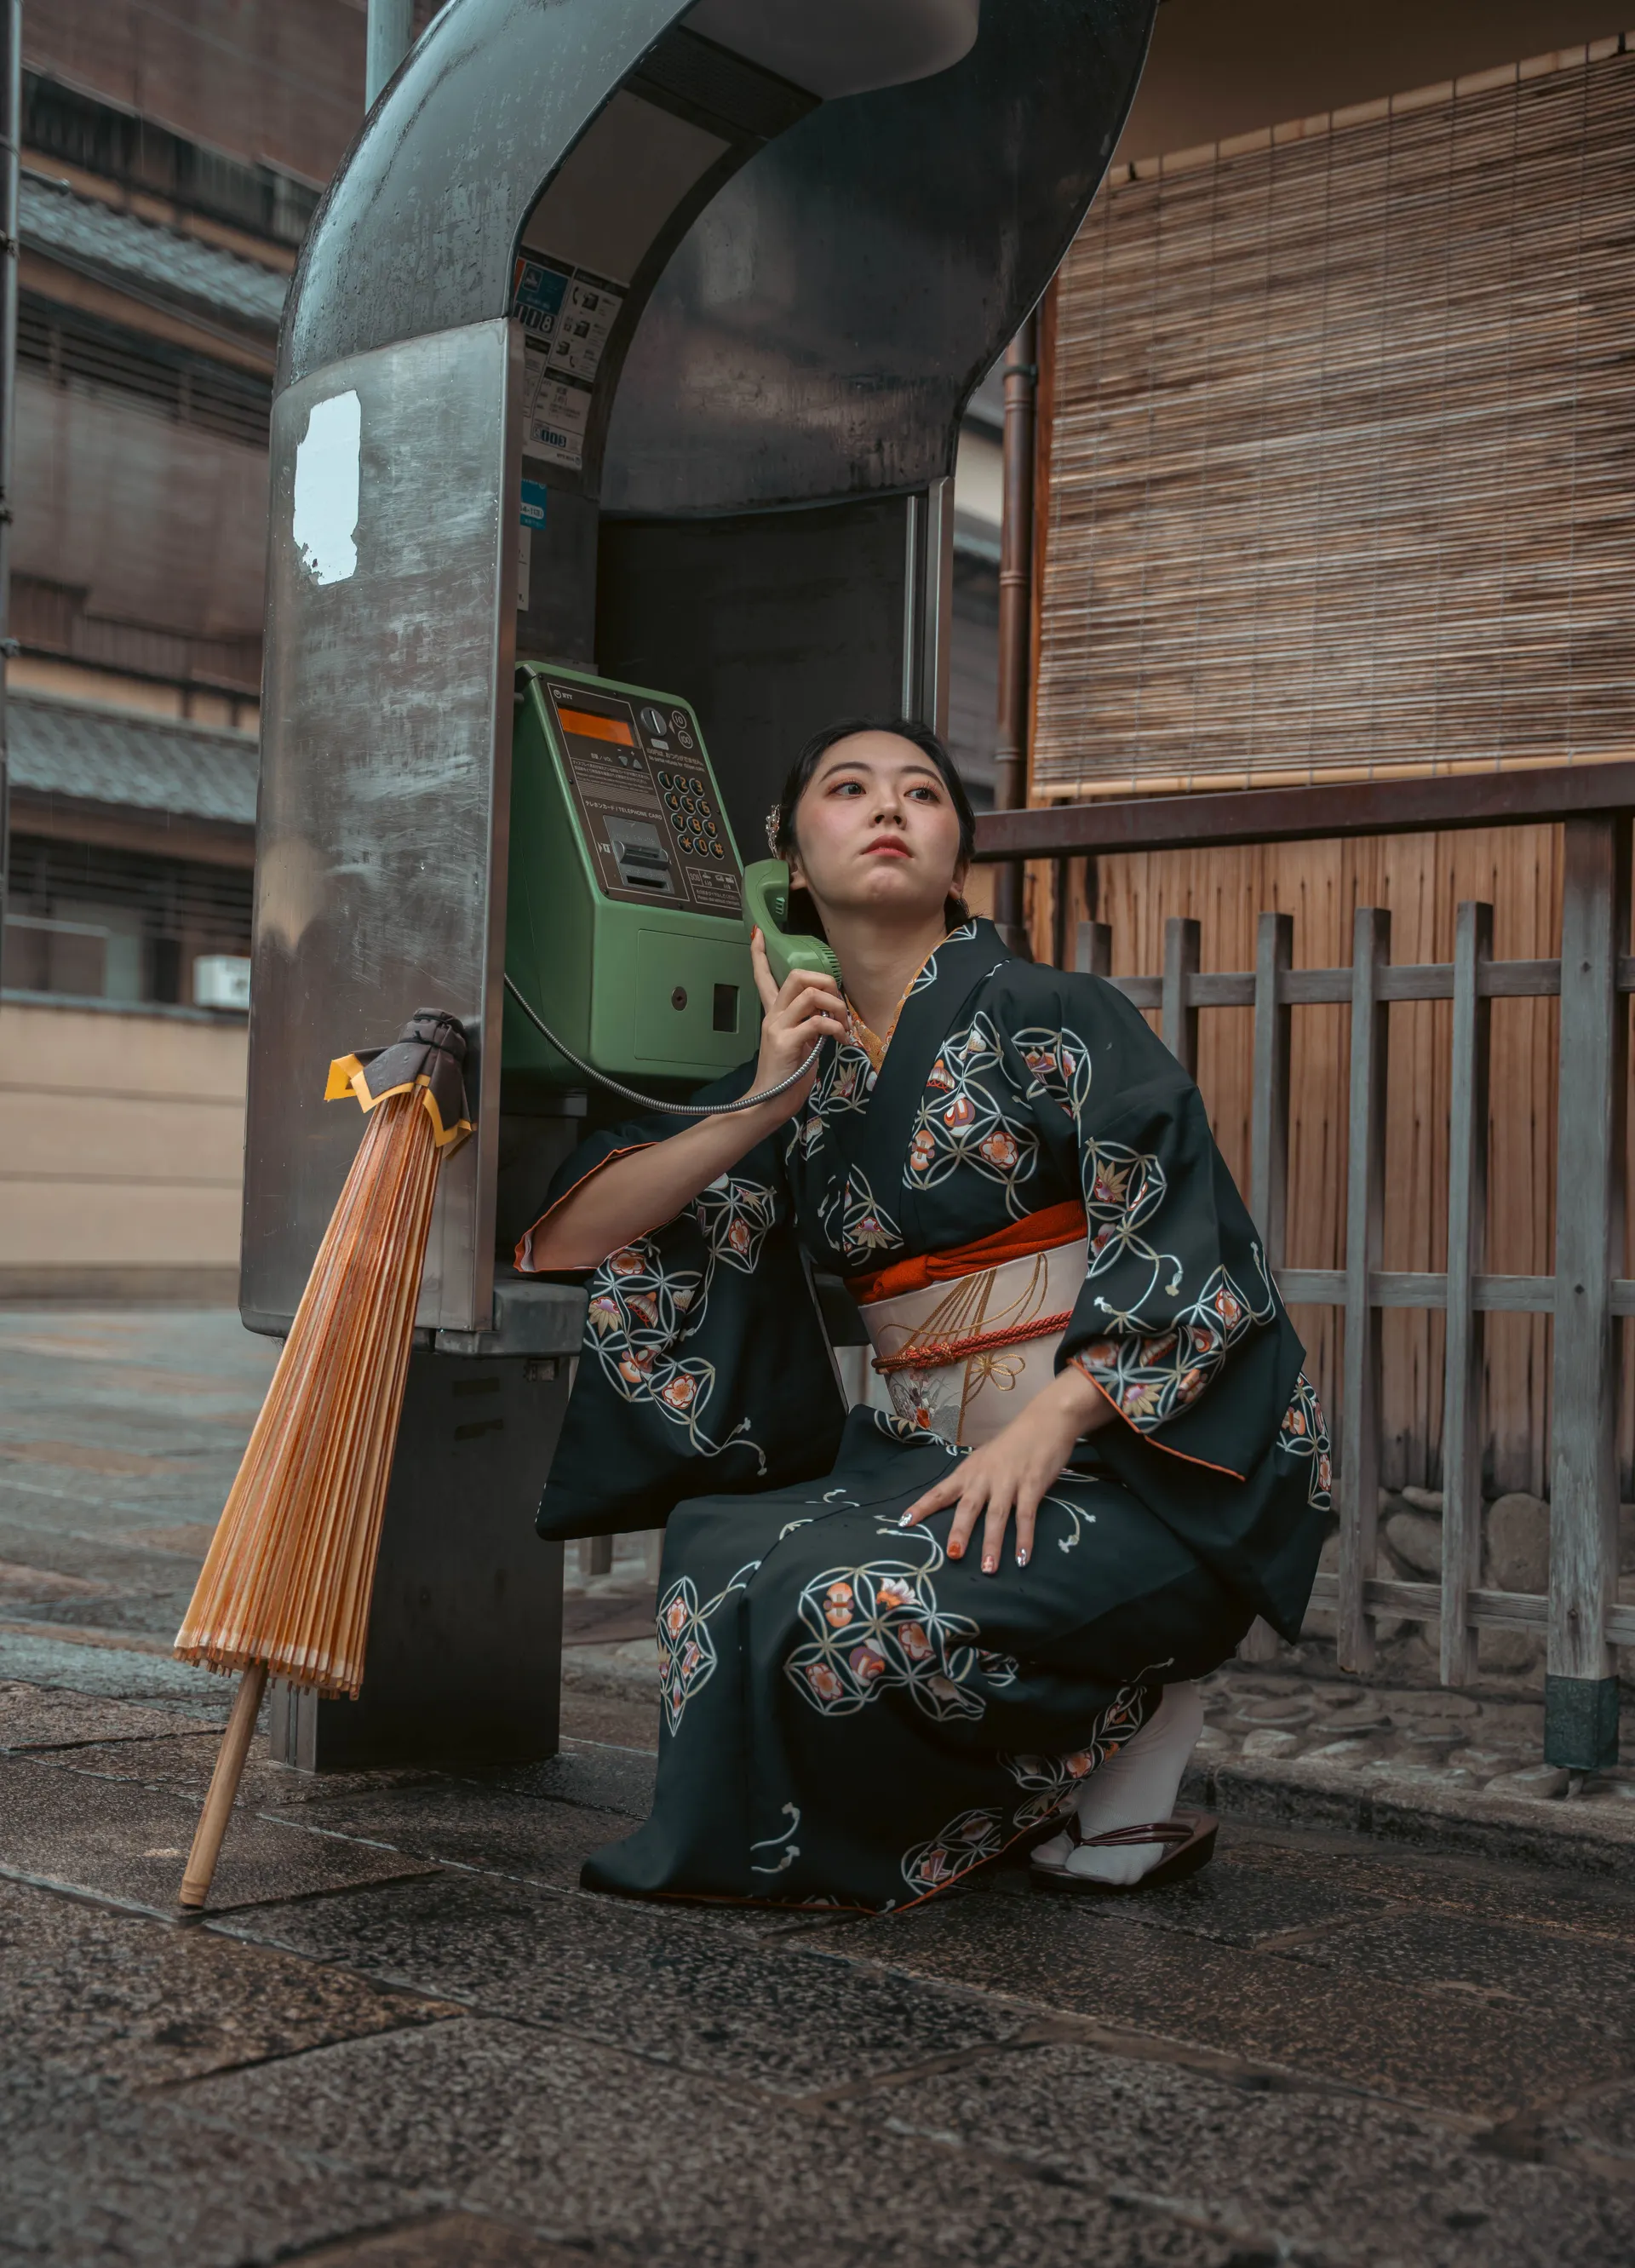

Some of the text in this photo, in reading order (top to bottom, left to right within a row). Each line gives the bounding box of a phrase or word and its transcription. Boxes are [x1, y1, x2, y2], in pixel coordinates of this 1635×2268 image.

[674, 715, 684, 724] 10
[665, 774, 670, 786] 1
[680, 776, 688, 789] 2
[695, 779, 703, 792] 3
[671, 795, 678, 807] 4
[686, 797, 694, 810] 5
[702, 801, 710, 813] 6
[618, 807, 647, 817] TELEPHONE
[677, 815, 683, 827] 7
[691, 818, 701, 831] 8
[708, 821, 715, 834] 9
[698, 838, 708, 852] 0
[689, 873, 700, 881] SOS
